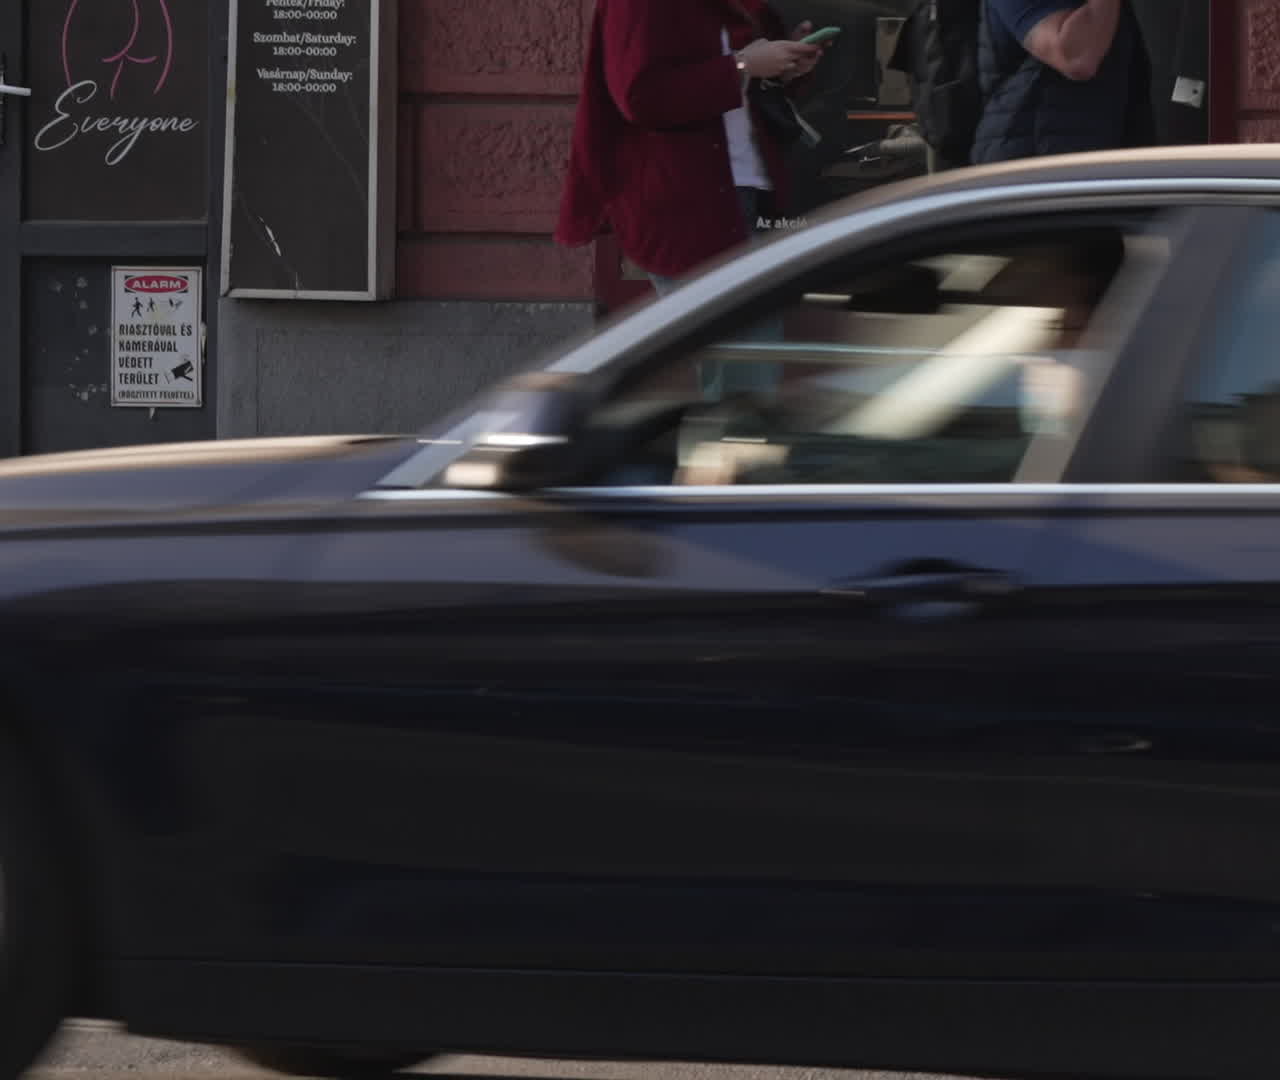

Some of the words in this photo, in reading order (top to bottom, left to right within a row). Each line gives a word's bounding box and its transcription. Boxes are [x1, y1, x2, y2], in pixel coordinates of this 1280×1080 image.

[272, 10, 338, 20] 18:00-00:00
[272, 46, 337, 56] 18:00-00:00
[271, 82, 337, 93] 18:00-00:00
[34, 80, 199, 166] Everyone
[132, 280, 182, 288] ALARM
[119, 323, 177, 336] RIASZTÓVAL
[181, 323, 192, 336] ÉS
[119, 339, 178, 353] KAMERÁVAL
[119, 355, 153, 369] VÉDETT
[119, 371, 159, 385] TERÜLET
